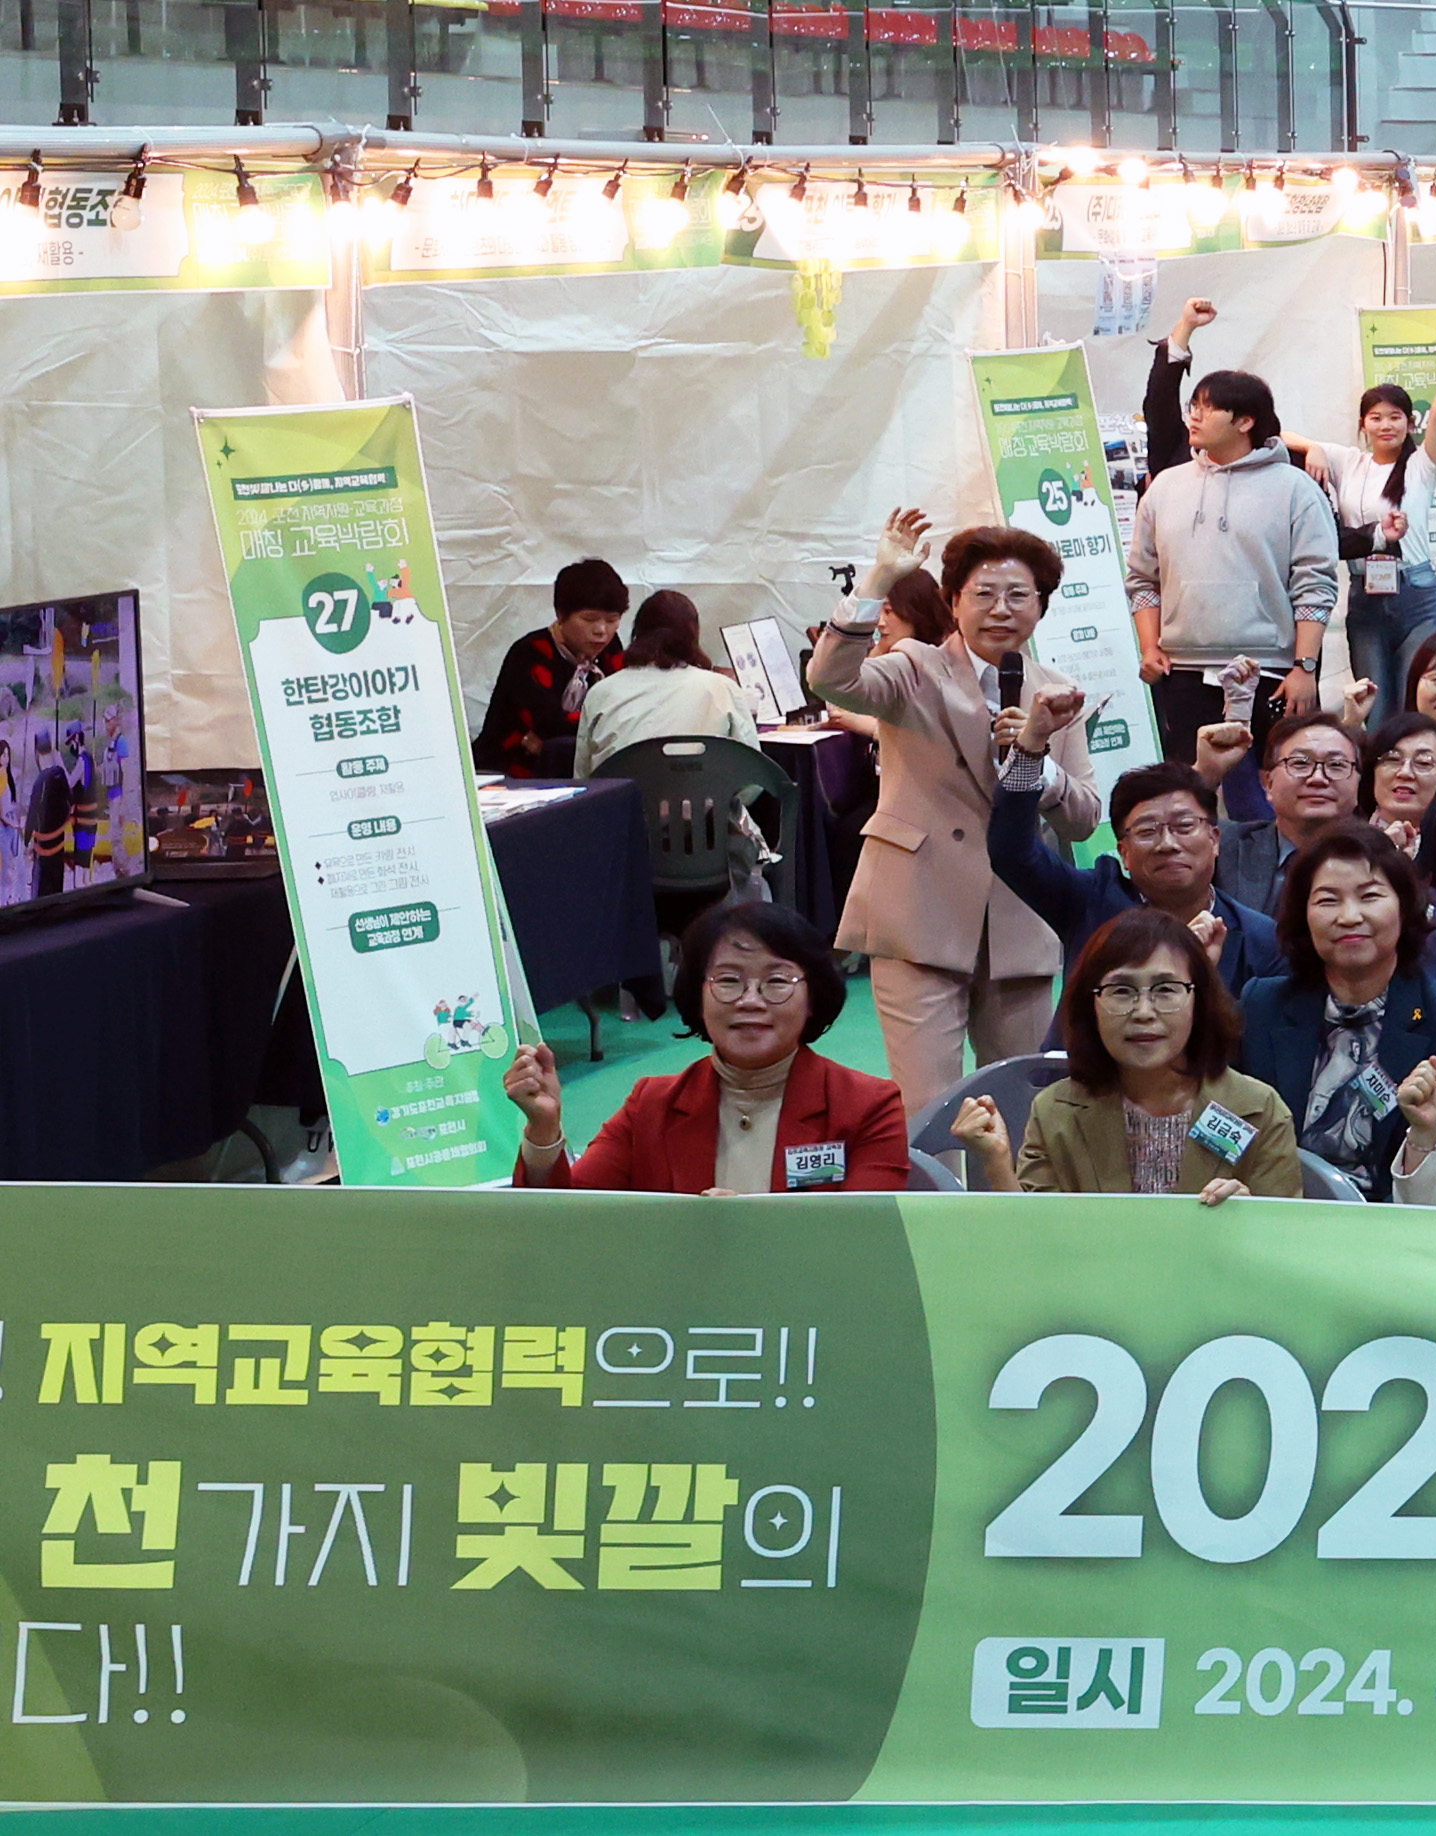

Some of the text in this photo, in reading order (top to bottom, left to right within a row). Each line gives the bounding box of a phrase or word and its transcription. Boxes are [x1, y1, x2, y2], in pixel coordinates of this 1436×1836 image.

[1041, 480, 1069, 512] 25
[240, 517, 409, 560] 매칭 교육박람회
[1087, 533, 1112, 556] 향기
[308, 589, 358, 634] 27
[281, 664, 420, 707] 한탄강이야기
[309, 705, 401, 742] 협동조합
[354, 908, 432, 933] 선생님이 제안하는
[1204, 1113, 1244, 1143] 김금숙
[794, 1153, 837, 1171] 김영리
[39, 1321, 817, 1409] 지역교육협력으로!!
[450, 1462, 843, 1590] 빛깔의
[12, 1621, 187, 1725] 다!!
[1005, 1646, 1144, 1717] 일시
[1194, 1647, 1413, 1719] 2024.
